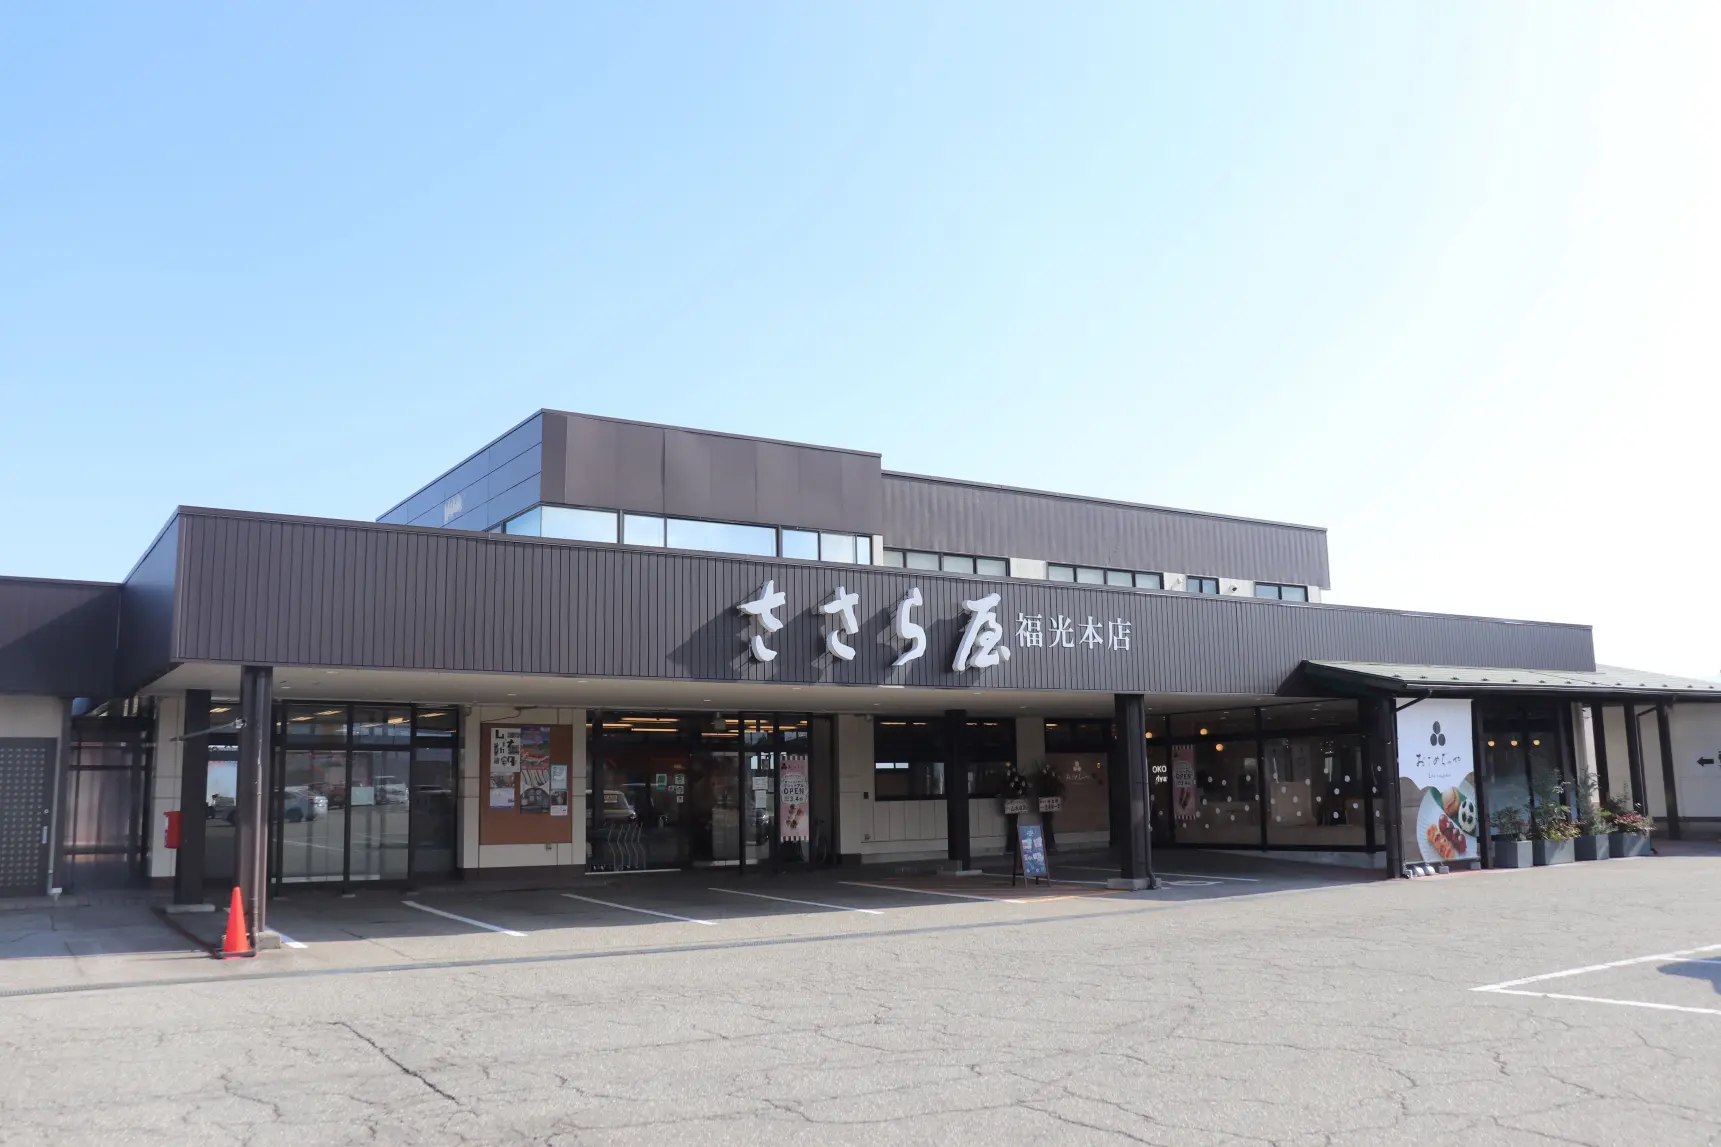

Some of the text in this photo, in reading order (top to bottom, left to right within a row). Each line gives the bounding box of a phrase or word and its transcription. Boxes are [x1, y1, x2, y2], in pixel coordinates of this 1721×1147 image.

[737, 580, 1131, 671] ささら屋 福光本店
